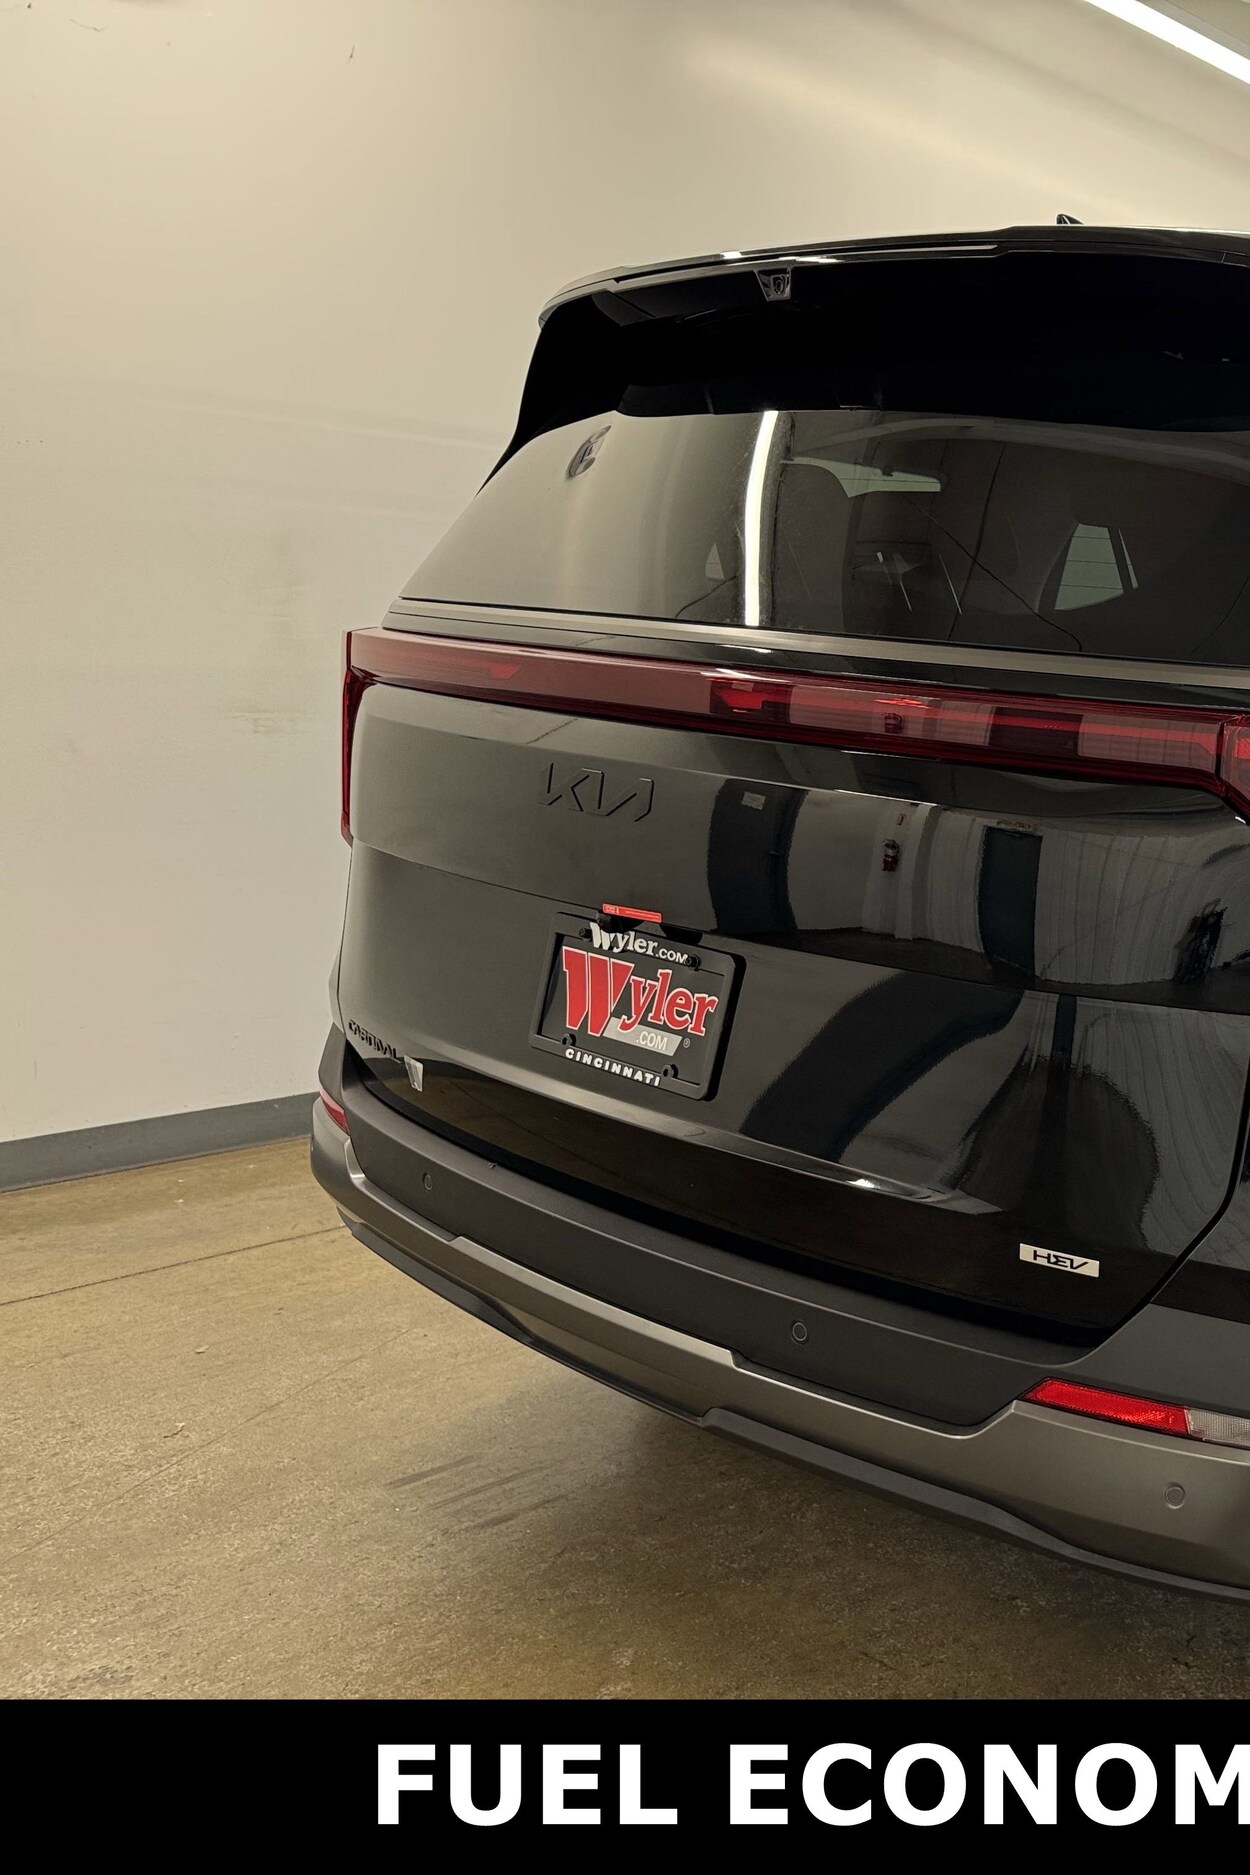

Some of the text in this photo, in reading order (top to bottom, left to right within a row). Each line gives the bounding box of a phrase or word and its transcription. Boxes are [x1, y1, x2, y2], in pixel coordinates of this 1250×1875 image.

[561, 945, 719, 1037] Wyler
[565, 1048, 661, 1087] CINCINNATI
[1033, 1249, 1089, 1270] HEV
